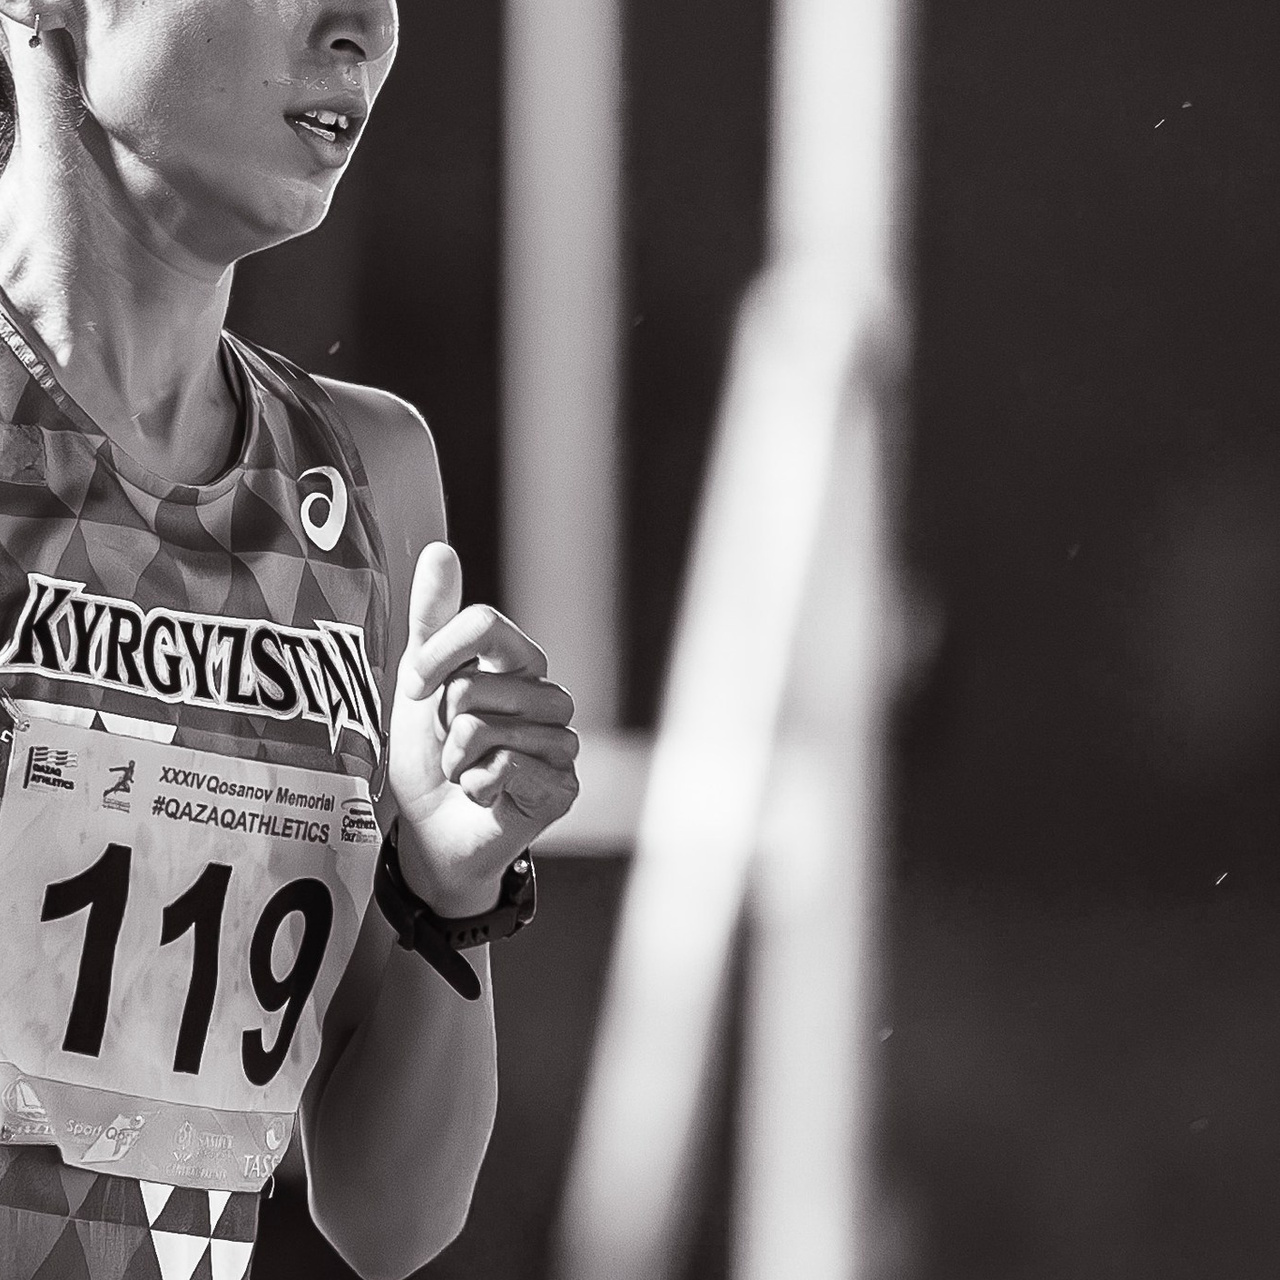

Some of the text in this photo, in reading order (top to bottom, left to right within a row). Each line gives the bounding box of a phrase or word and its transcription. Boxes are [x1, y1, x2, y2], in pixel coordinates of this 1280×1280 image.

[158, 765, 336, 813] XXXIV Qosanov Memorial
[151, 795, 331, 845] #QAZAQATHLETICS
[40, 842, 333, 1086] 119
